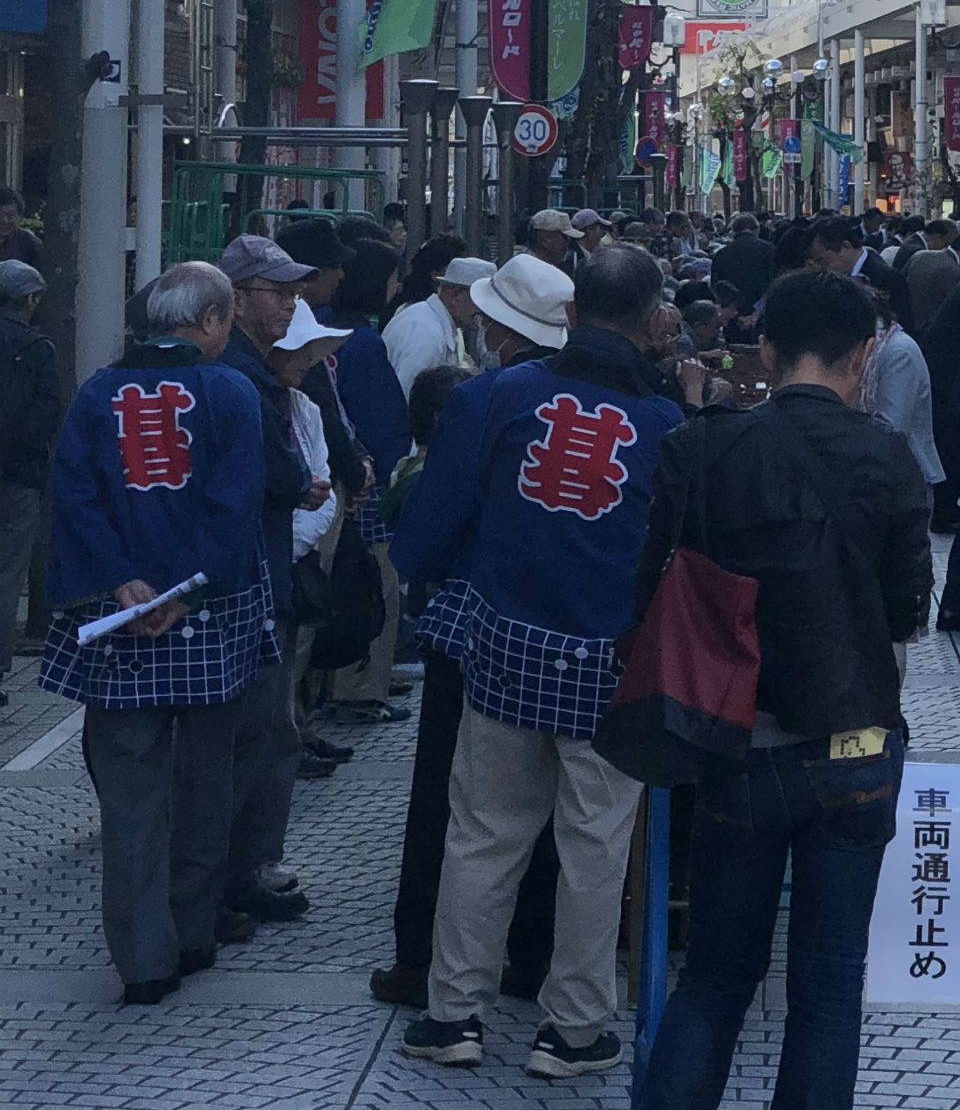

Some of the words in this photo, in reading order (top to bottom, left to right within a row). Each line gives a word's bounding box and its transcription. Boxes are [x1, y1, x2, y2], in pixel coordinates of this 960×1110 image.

[518, 119, 546, 141] 30
[112, 381, 196, 491] 碁
[517, 393, 638, 521] 碁
[908, 787, 953, 980] 車両通行止め
